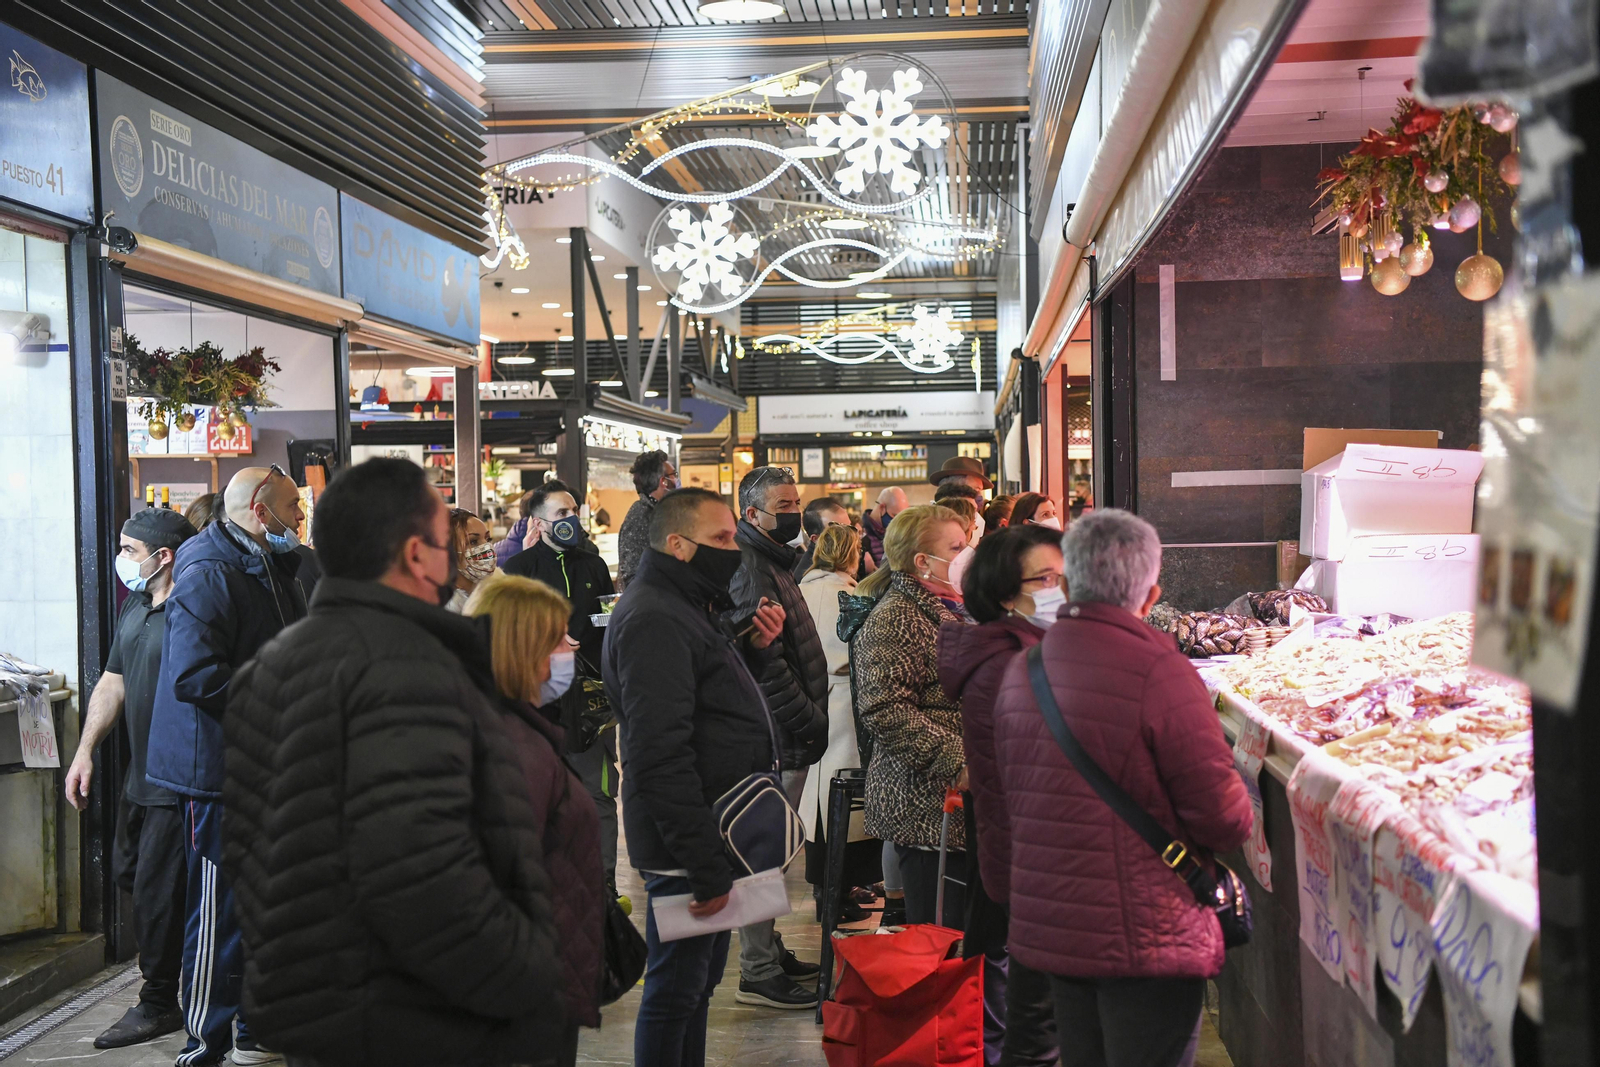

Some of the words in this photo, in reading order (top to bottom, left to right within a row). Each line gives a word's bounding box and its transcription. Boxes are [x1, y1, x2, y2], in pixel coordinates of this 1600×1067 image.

[151, 113, 173, 135] SERIE
[173, 124, 191, 143] ORO
[118, 152, 136, 170] ORO
[3, 160, 43, 189] PUESTO
[46, 163, 64, 196] 41
[151, 140, 239, 207] DELICIAS
[242, 180, 272, 221] DEL
[275, 195, 309, 236] MAR
[154, 186, 209, 220] CONSERVAS
[353, 222, 437, 285] DAVID
[113, 362, 123, 373] PAGO
[115, 375, 123, 385] CON
[169, 491, 201, 500] ripadvisor
[21, 729, 57, 758] MOTRIL
